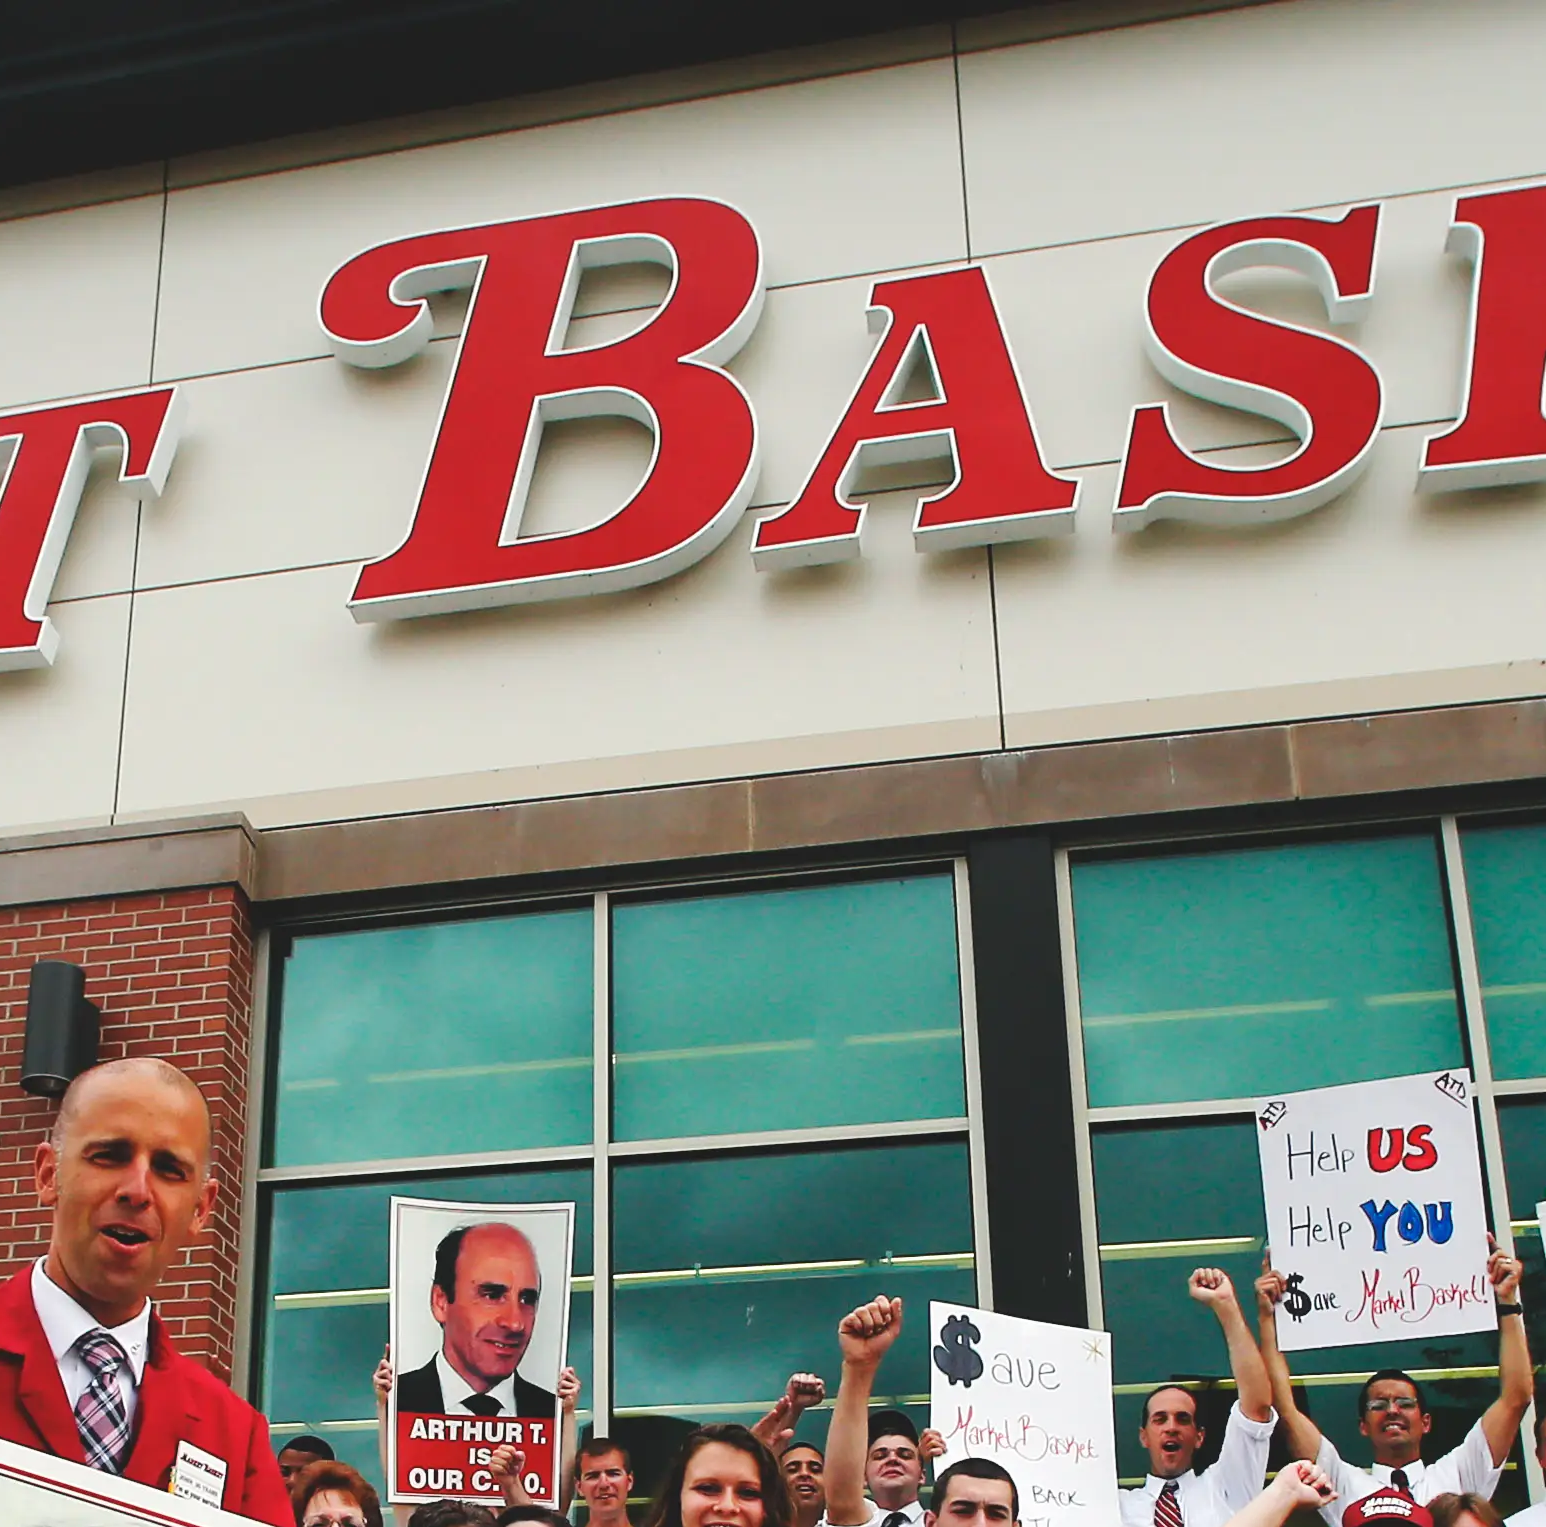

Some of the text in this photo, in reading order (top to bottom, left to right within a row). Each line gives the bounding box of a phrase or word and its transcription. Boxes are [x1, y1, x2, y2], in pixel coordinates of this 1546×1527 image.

[1286, 1124, 1438, 1180] Help US
[1289, 1200, 1454, 1253] Help YOU
[409, 1418, 546, 1444] ARTHUR T.
[469, 1447, 492, 1465] IS
[408, 1467, 463, 1490] OUR
[1032, 1485, 1086, 1506] BACK
